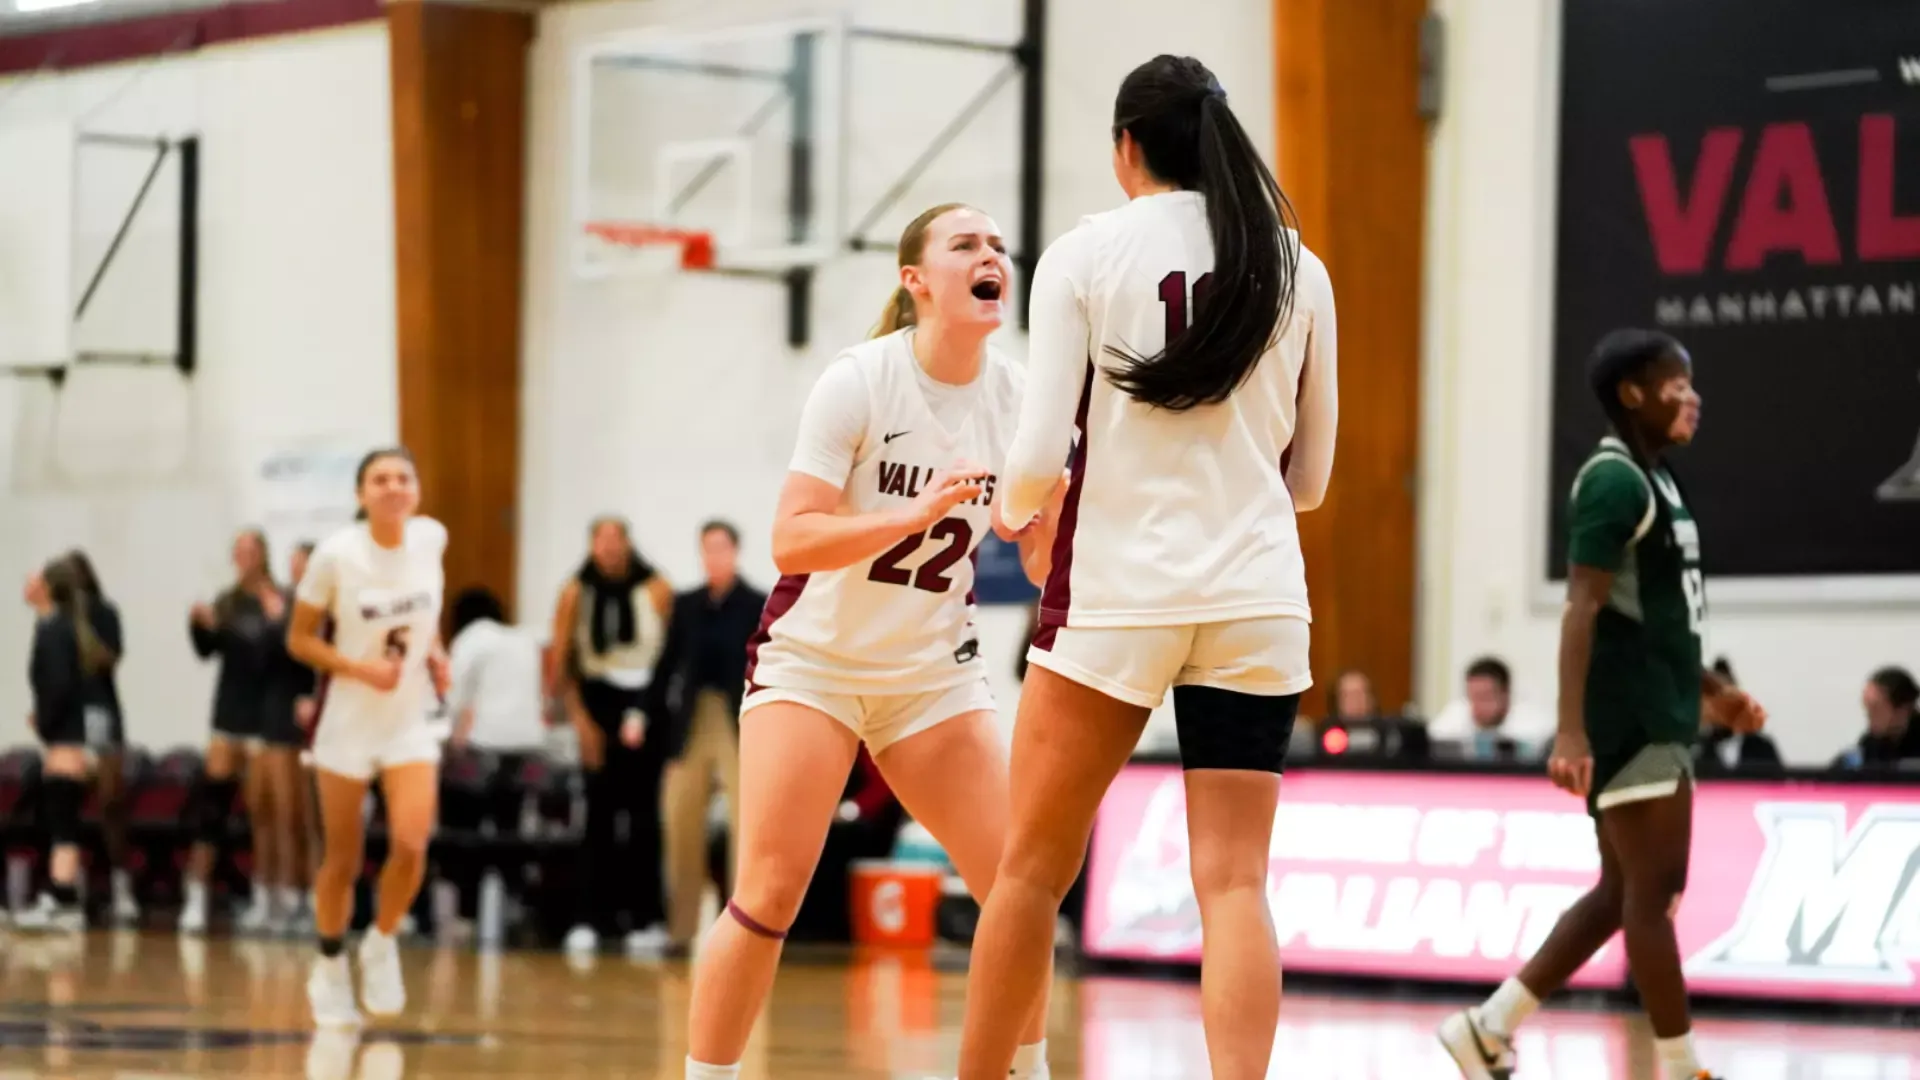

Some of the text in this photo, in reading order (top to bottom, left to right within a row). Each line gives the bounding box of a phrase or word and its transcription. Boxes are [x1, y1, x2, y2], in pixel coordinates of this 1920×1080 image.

[1629, 112, 1920, 276] VAL
[1656, 281, 1916, 326] MANHATTAN
[867, 516, 973, 593] 22
[1266, 872, 1607, 962] ALIANT
